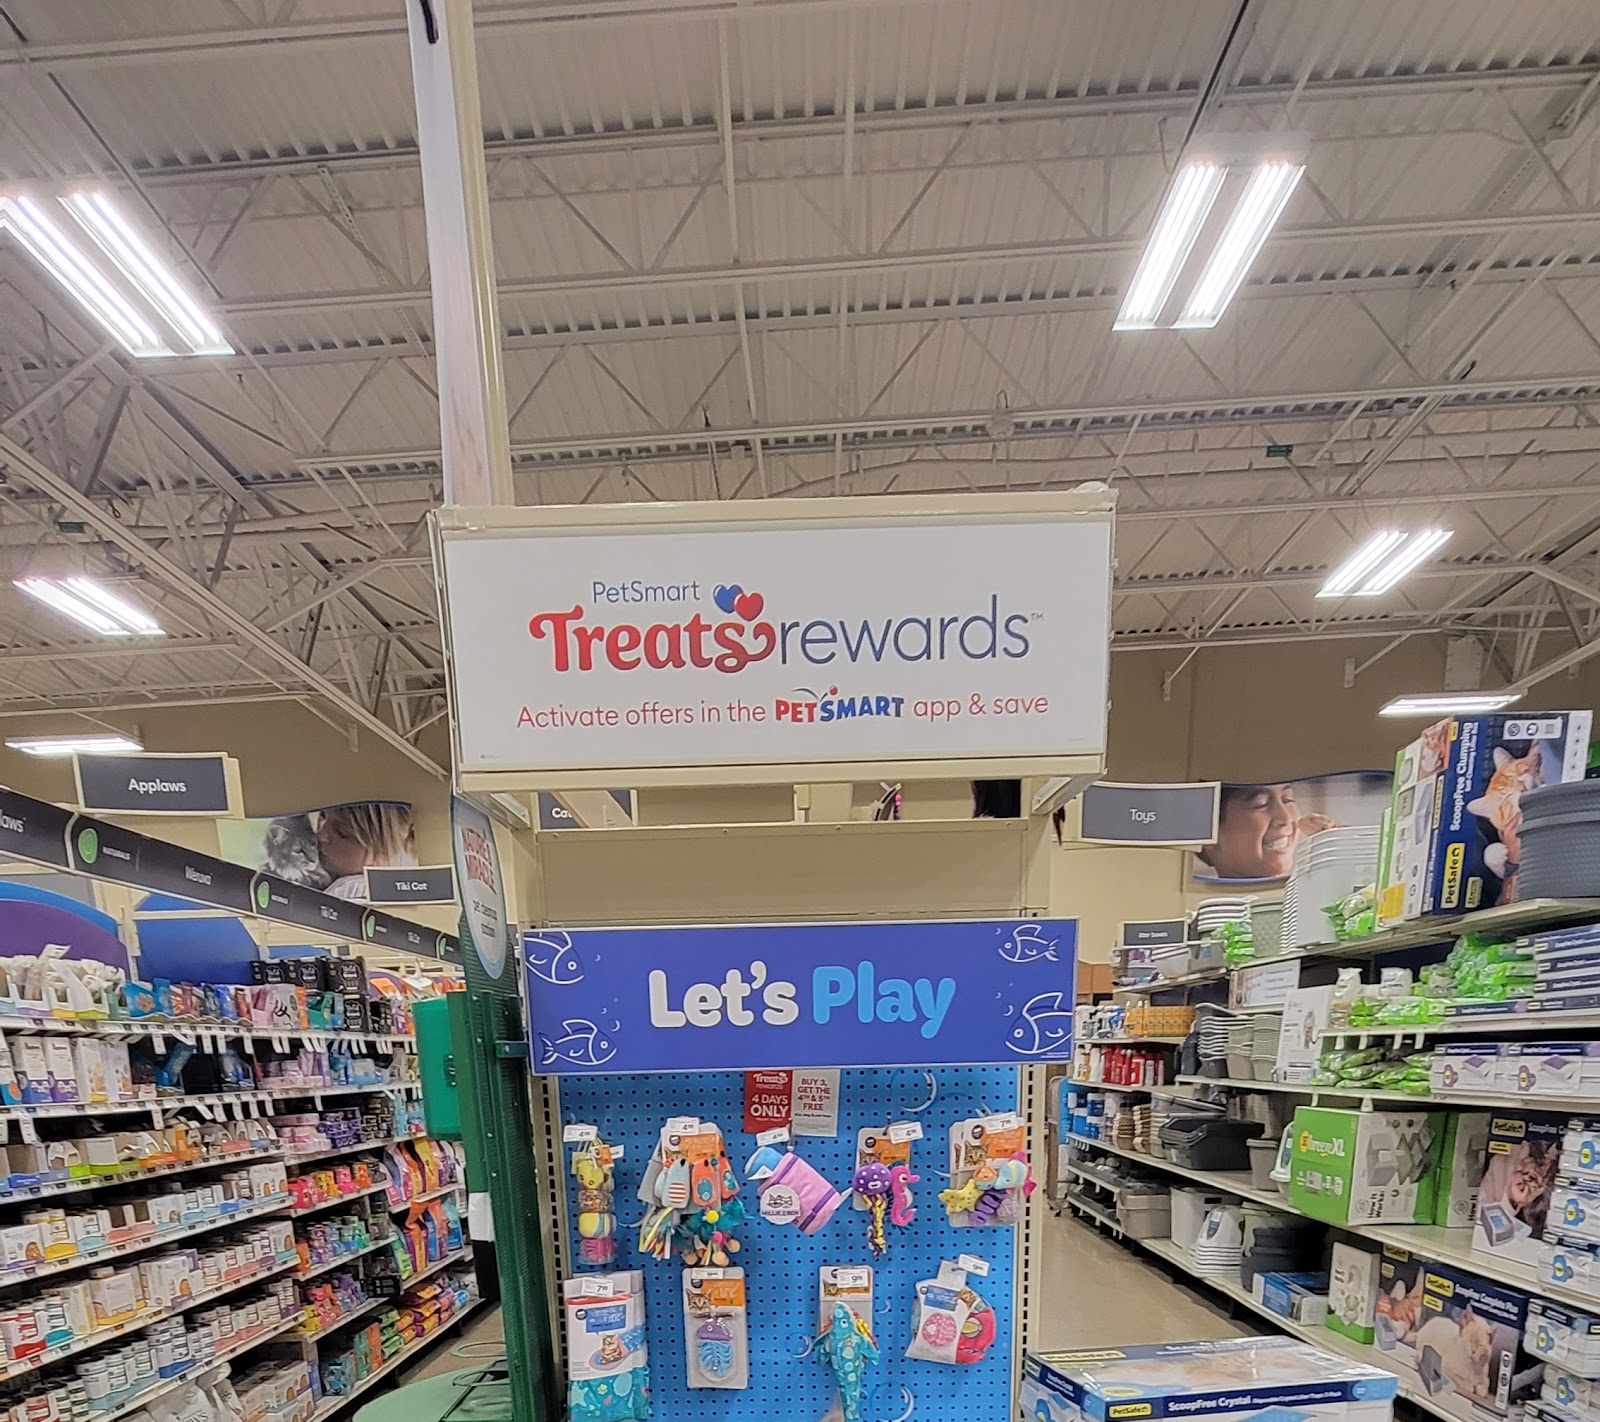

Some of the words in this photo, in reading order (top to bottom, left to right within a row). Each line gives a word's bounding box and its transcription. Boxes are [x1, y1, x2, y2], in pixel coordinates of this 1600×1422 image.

[592, 580, 700, 604] PetSmart
[529, 605, 775, 674] Treats
[780, 594, 1030, 665] rewards
[517, 706, 619, 729] Activate
[625, 703, 695, 725] offers
[701, 702, 720, 723] in
[727, 701, 766, 722] the
[775, 695, 904, 723] PETSMART
[913, 699, 961, 721] app
[968, 694, 987, 714] &
[993, 695, 1049, 715] save
[1456, 722, 1473, 774] Clumping
[128, 778, 187, 796] Applaws
[1129, 808, 1156, 824] Toys
[1444, 859, 1459, 904] PetSafe
[648, 960, 800, 1029] Let's
[812, 961, 956, 1039] Play
[752, 1094, 760, 1103] 4
[762, 1094, 788, 1104] DAYS
[797, 1086, 814, 1094] GET
[816, 1086, 831, 1094] THE
[750, 1104, 789, 1117] ONLY
[803, 1103, 824, 1111] FREE
[1111, 1406, 1142, 1417] PetSafe
[1168, 1399, 1217, 1412] ScoopFree
[1217, 1395, 1251, 1408] Crystal
